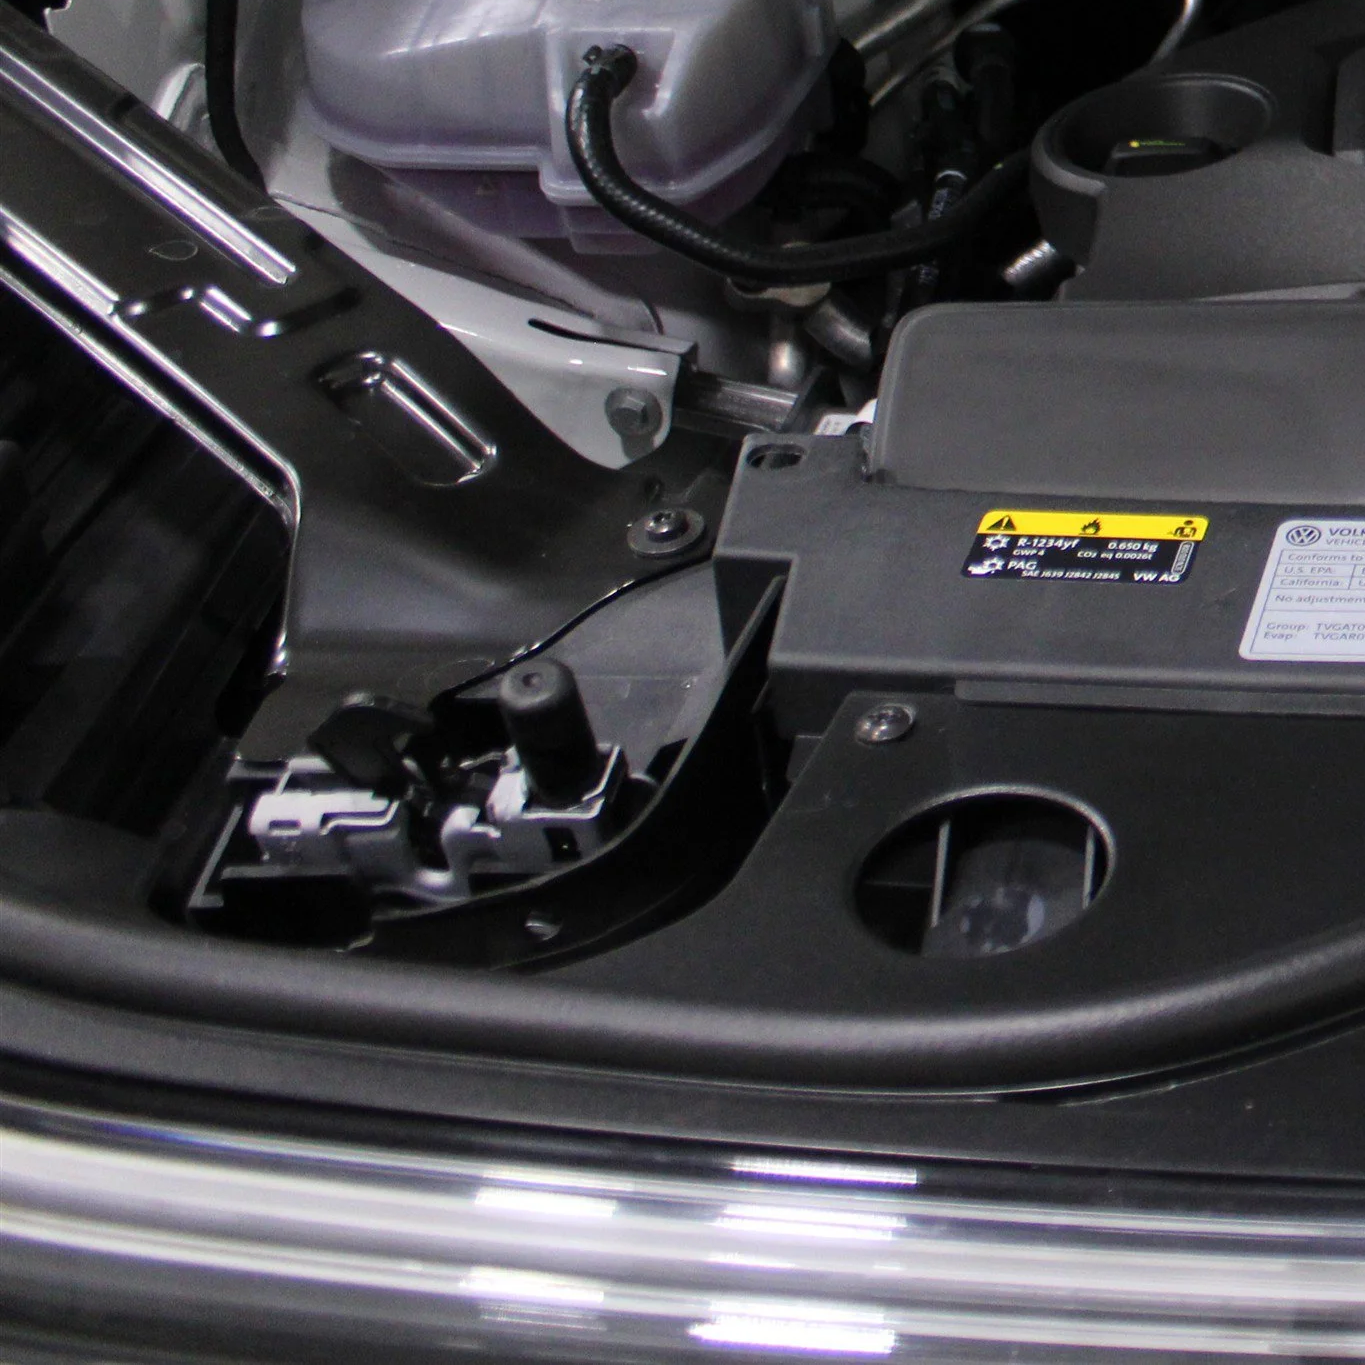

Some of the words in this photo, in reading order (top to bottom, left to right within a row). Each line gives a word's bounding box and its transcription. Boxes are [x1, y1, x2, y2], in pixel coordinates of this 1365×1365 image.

[1017, 537, 1080, 550] R-1234yf
[1107, 541, 1140, 550] 0.650
[1143, 543, 1158, 553] kg
[1013, 549, 1037, 557] GWP
[1038, 549, 1045, 557] 4
[1288, 553, 1347, 562] Conforms
[1350, 554, 1363, 562] to
[1007, 561, 1037, 570] PAG
[1021, 570, 1039, 578] SAE
[1040, 570, 1064, 579] J639
[1064, 571, 1091, 580] J2842
[1092, 572, 1120, 581] J2845
[1133, 573, 1156, 582] VW
[1159, 573, 1181, 582] AG
